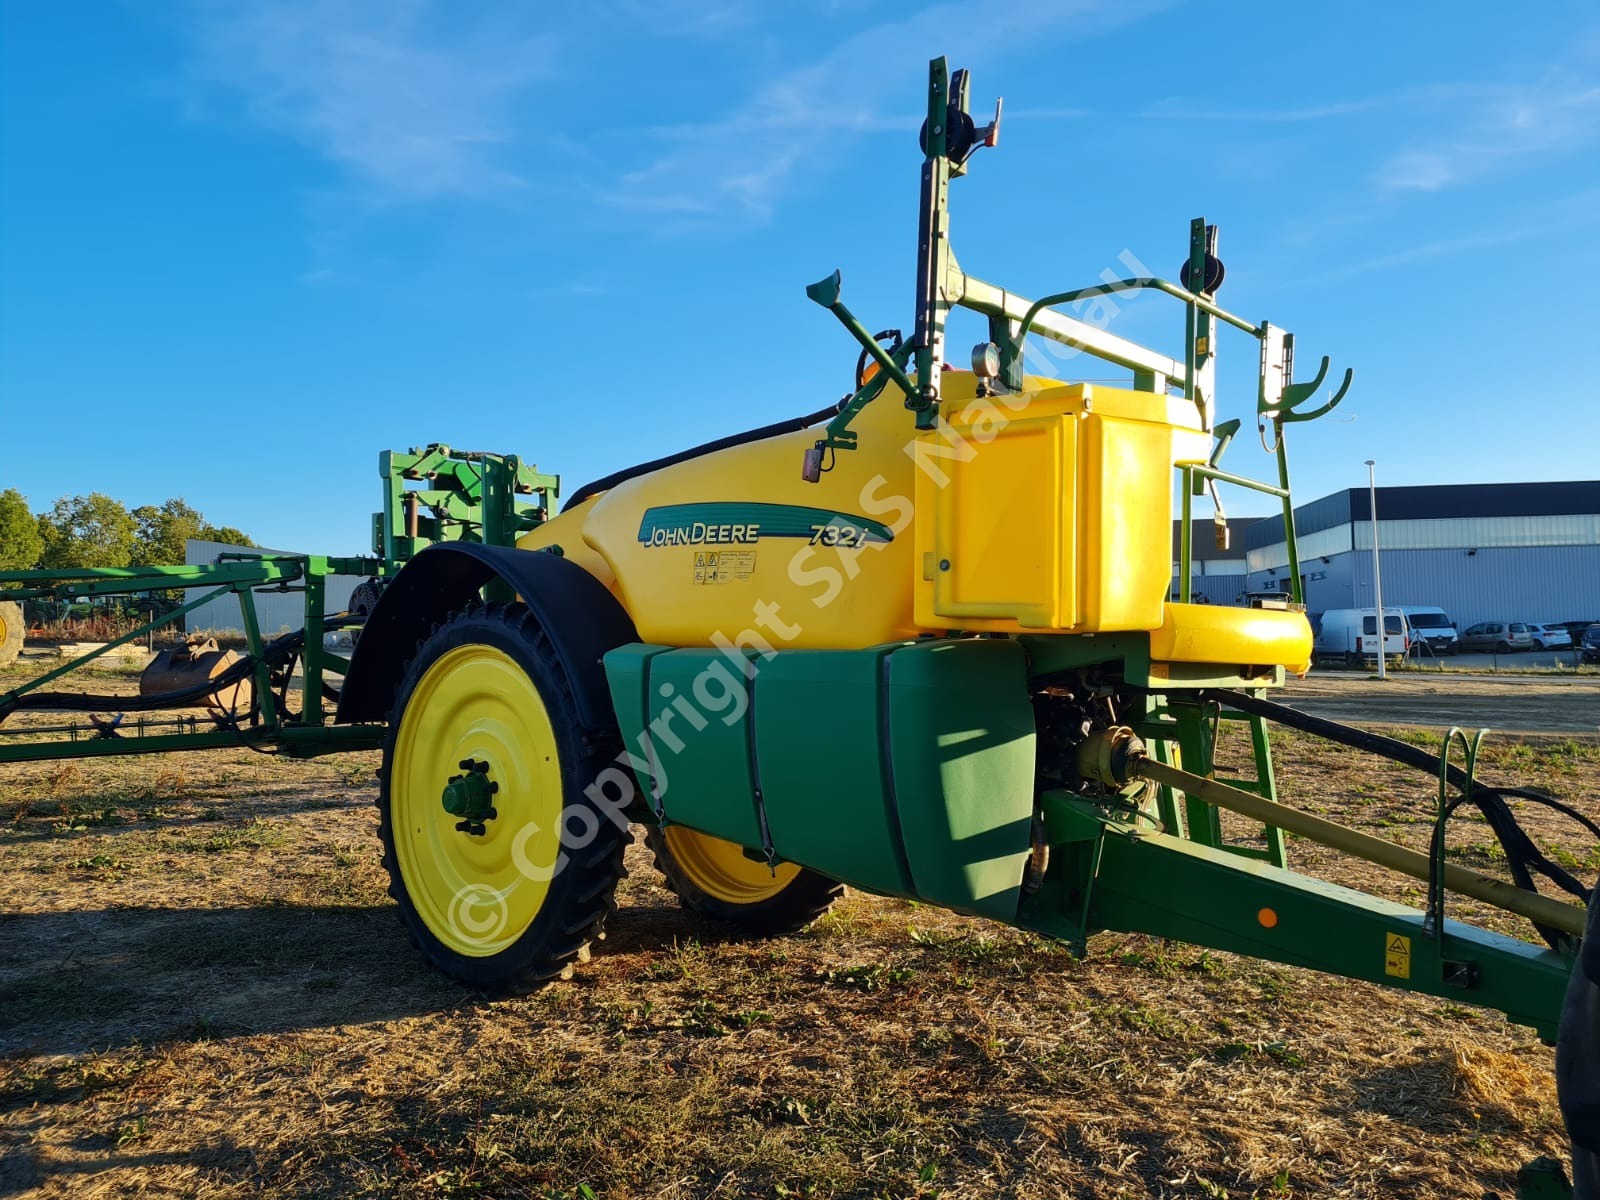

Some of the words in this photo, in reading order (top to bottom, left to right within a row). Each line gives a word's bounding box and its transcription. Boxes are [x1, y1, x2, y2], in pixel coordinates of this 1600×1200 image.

[644, 525, 690, 547] JOHN
[690, 522, 760, 544] DEERE
[809, 525, 869, 548] 732i
